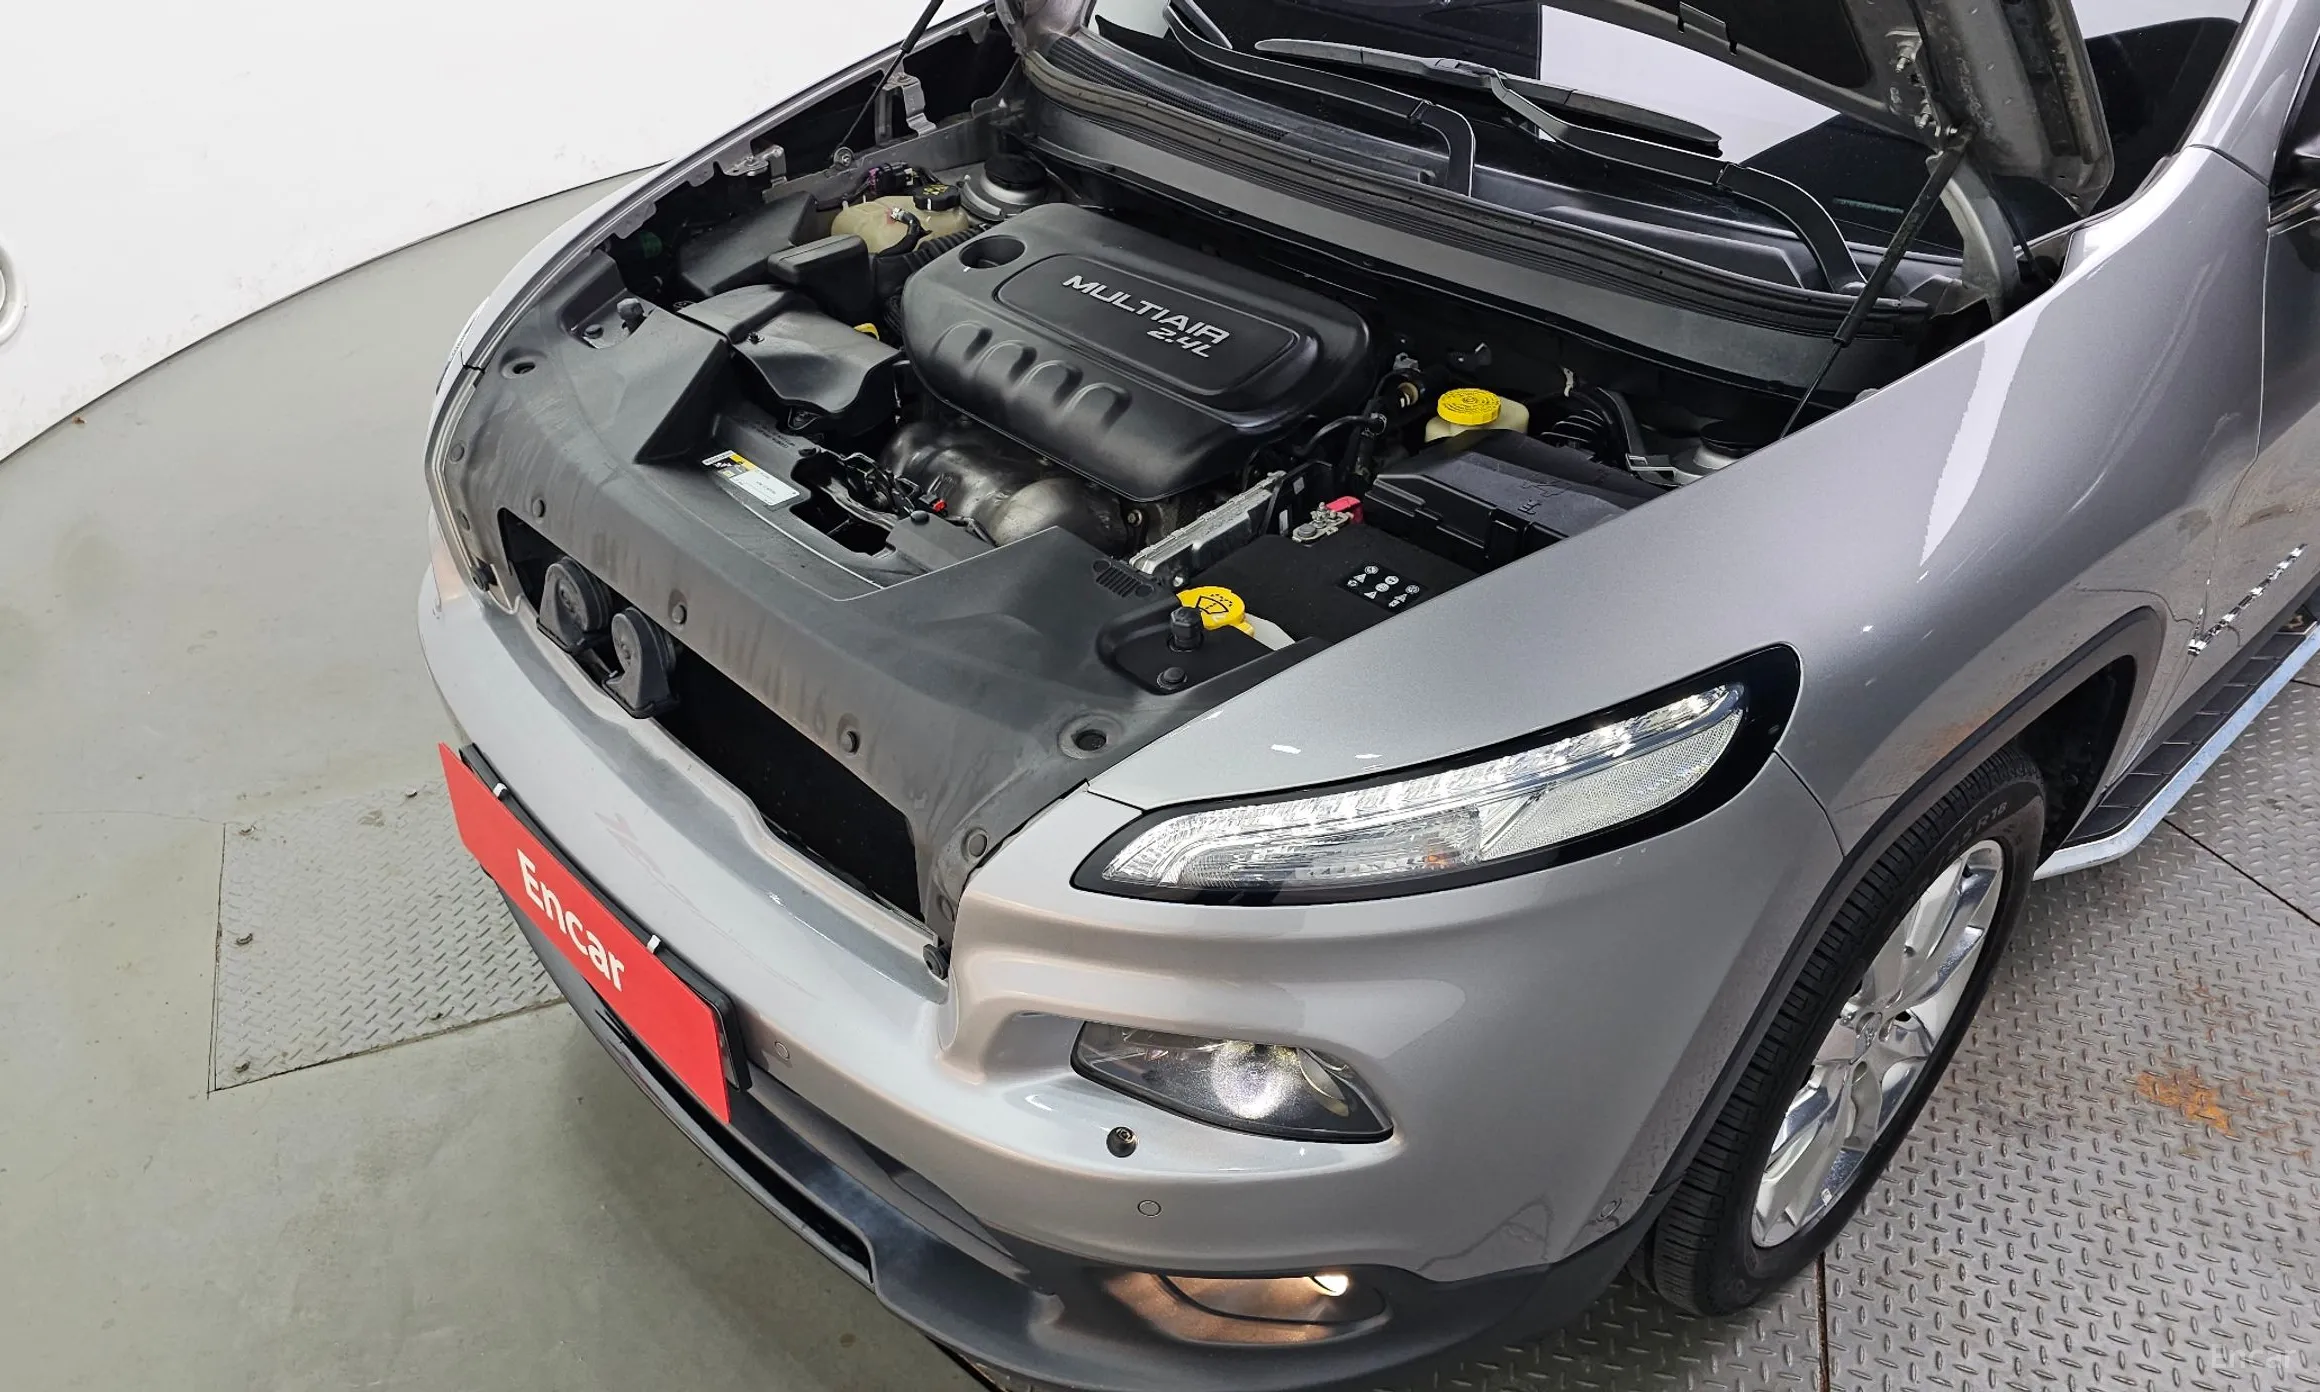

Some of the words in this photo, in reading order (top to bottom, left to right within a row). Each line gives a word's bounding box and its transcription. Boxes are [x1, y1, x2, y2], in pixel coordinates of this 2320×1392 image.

[1062, 275, 1231, 345] MULTIAIR
[1146, 327, 1213, 358] 2.4L
[517, 848, 625, 992] Encar
